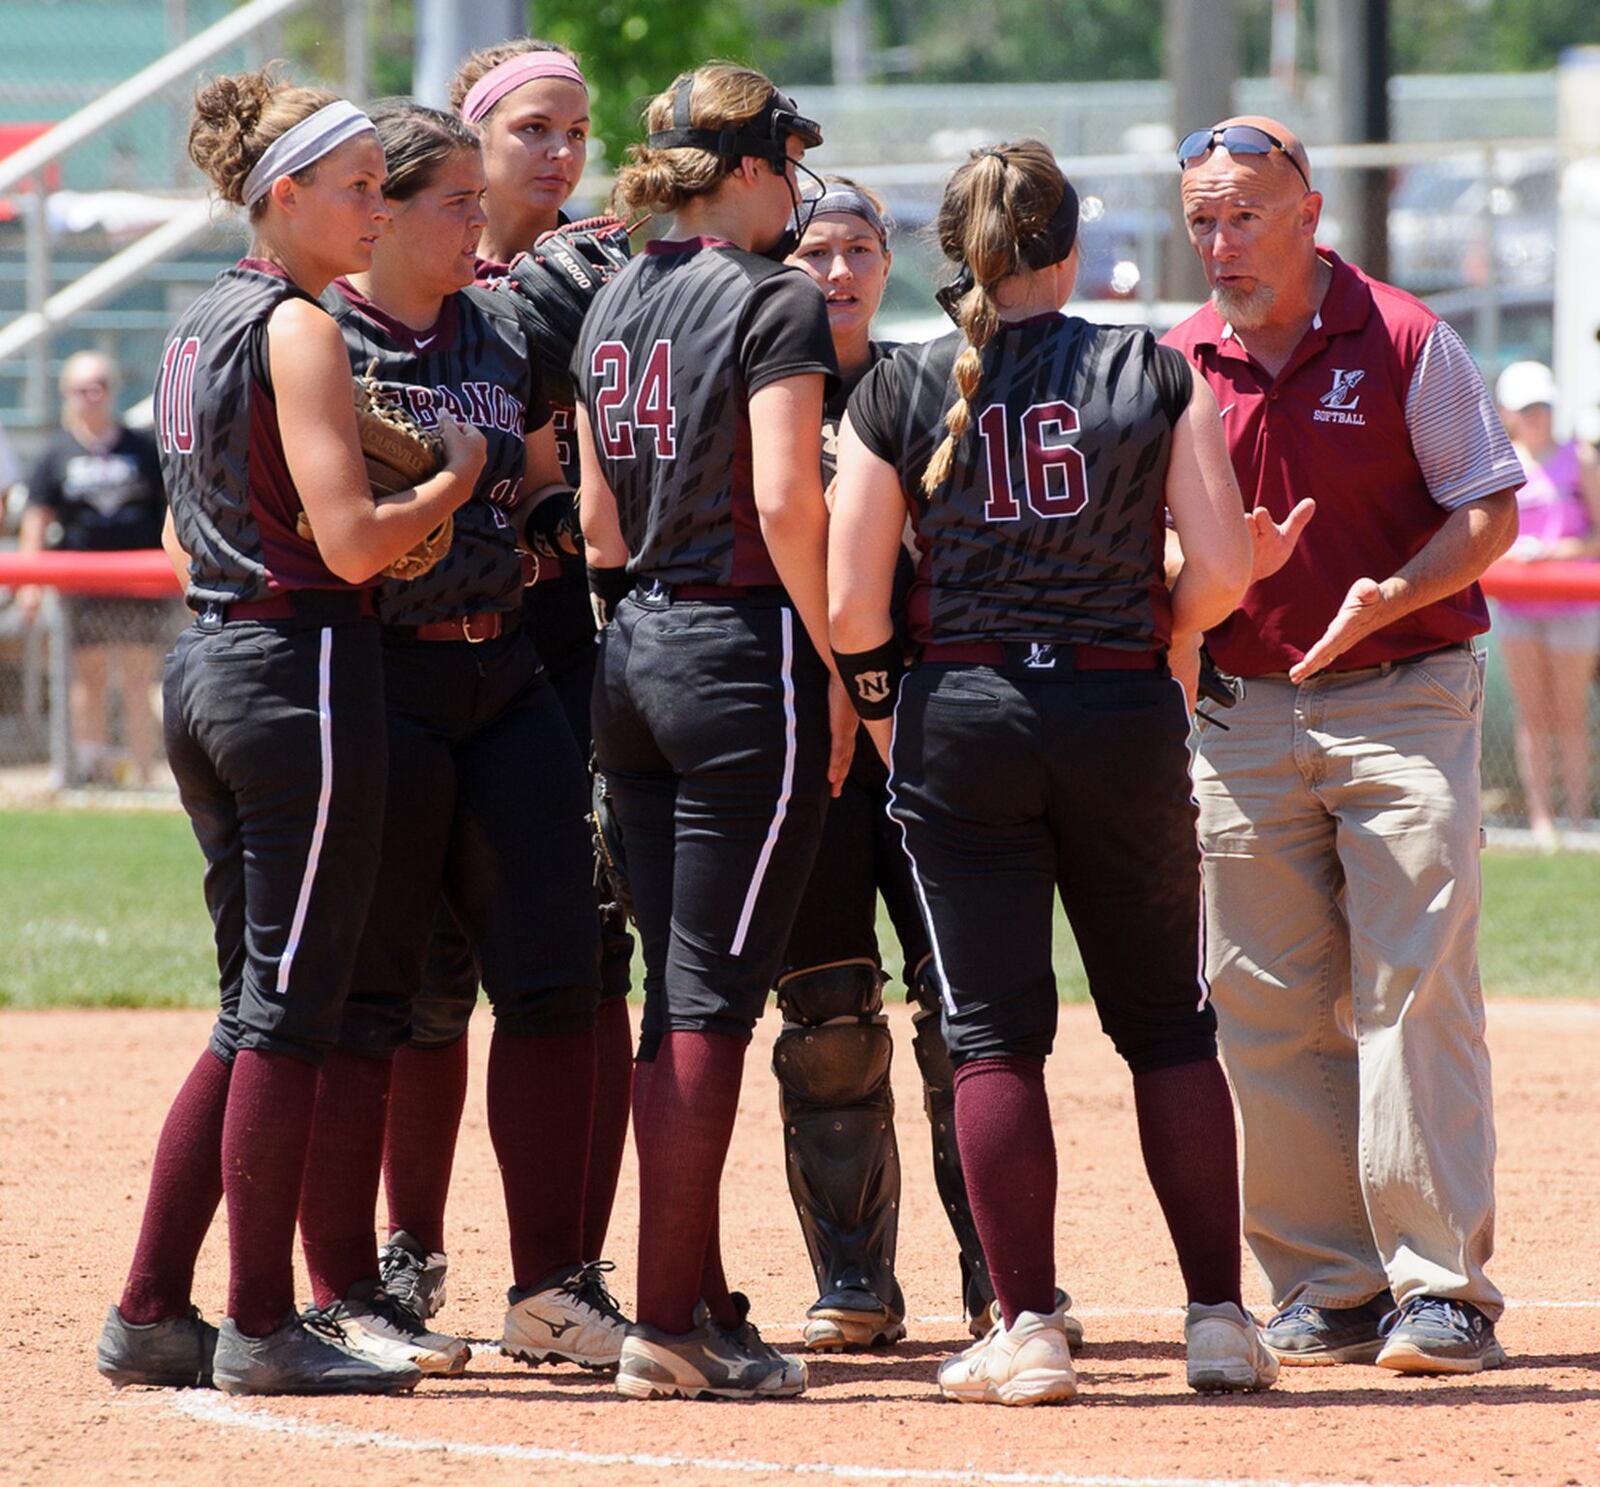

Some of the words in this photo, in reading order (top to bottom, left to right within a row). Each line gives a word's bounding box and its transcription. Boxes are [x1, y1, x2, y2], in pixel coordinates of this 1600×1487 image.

[554, 251, 592, 289] A2000
[161, 337, 200, 453] 10
[591, 339, 676, 459] 24
[1312, 409, 1366, 426] SOFTBALL
[979, 400, 1089, 521] 16
